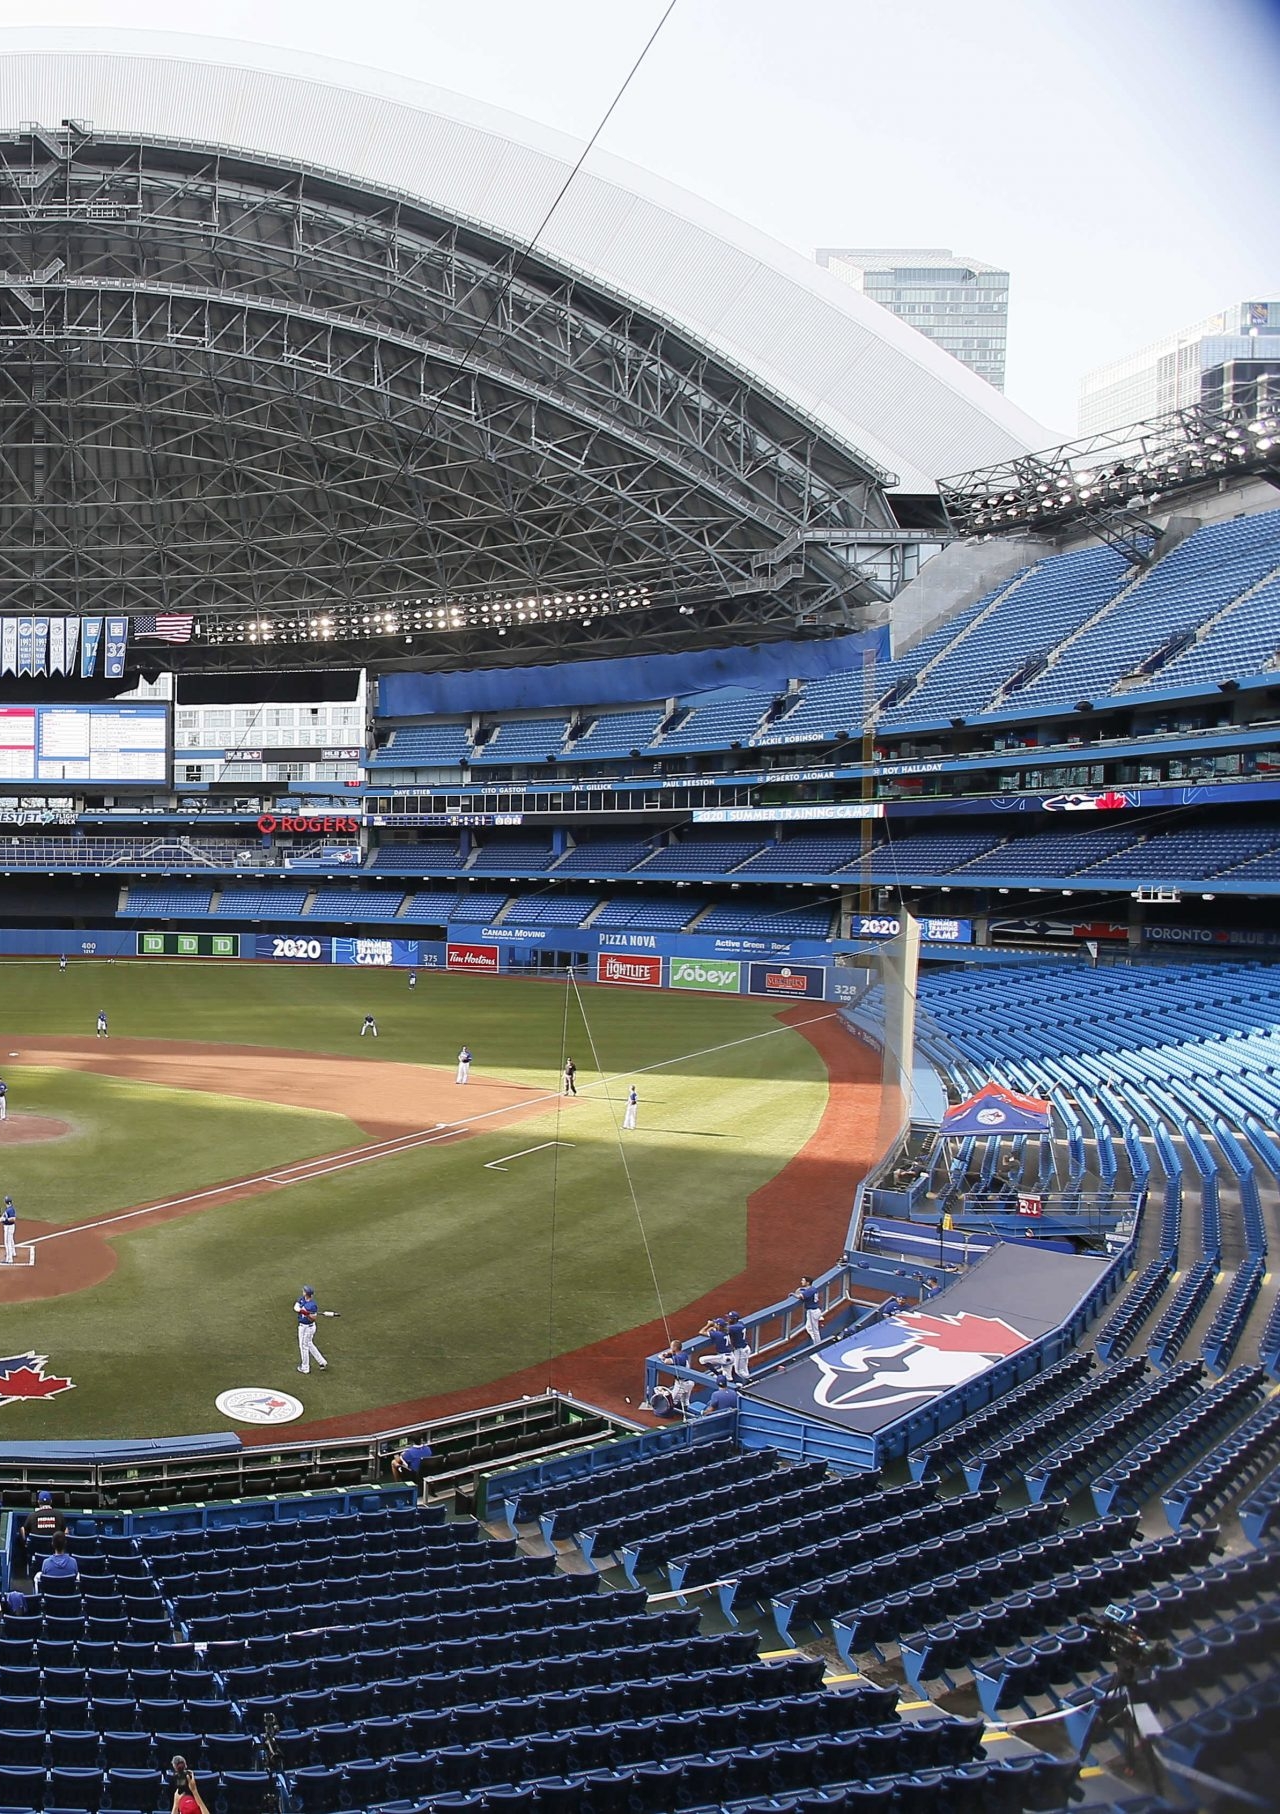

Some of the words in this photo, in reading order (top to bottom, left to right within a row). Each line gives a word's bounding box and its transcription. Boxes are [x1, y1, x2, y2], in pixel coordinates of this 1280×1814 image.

[107, 643, 125, 657] 32
[757, 737, 783, 746] JACKIE
[785, 733, 824, 743] ROBINSON
[883, 766, 898, 775] ROY
[901, 762, 943, 773] HALLADAY
[766, 773, 800, 782] ROBERTO
[803, 771, 835, 780] ALOMAR
[699, 811, 724, 821] 2020
[730, 809, 775, 821] SUMMER
[779, 807, 836, 820] TRAINING
[836, 806, 870, 818] CAMP
[281, 816, 359, 833] ROGERS
[482, 928, 513, 937] CANADA
[514, 930, 546, 938] MOVING
[860, 920, 900, 935] 2020
[599, 933, 628, 946] PIZZA
[630, 935, 656, 948] NOVA
[928, 931, 959, 940] CAMP
[1145, 927, 1213, 941] TORONTO
[1230, 931, 1265, 945] BLUE
[81, 942, 96, 950] 400
[146, 937, 162, 950] TD
[180, 938, 197, 951] TD
[214, 939, 231, 952] TD
[272, 939, 321, 959] 2020
[356, 940, 393, 949] SUMMER
[715, 939, 741, 948] Active
[742, 941, 765, 949] Green
[356, 953, 393, 965] CAMP
[423, 954, 438, 963] 375
[448, 951, 464, 964] Tim
[464, 952, 496, 966] Hortons
[673, 963, 737, 987] Sobeys
[833, 985, 857, 995] 328
